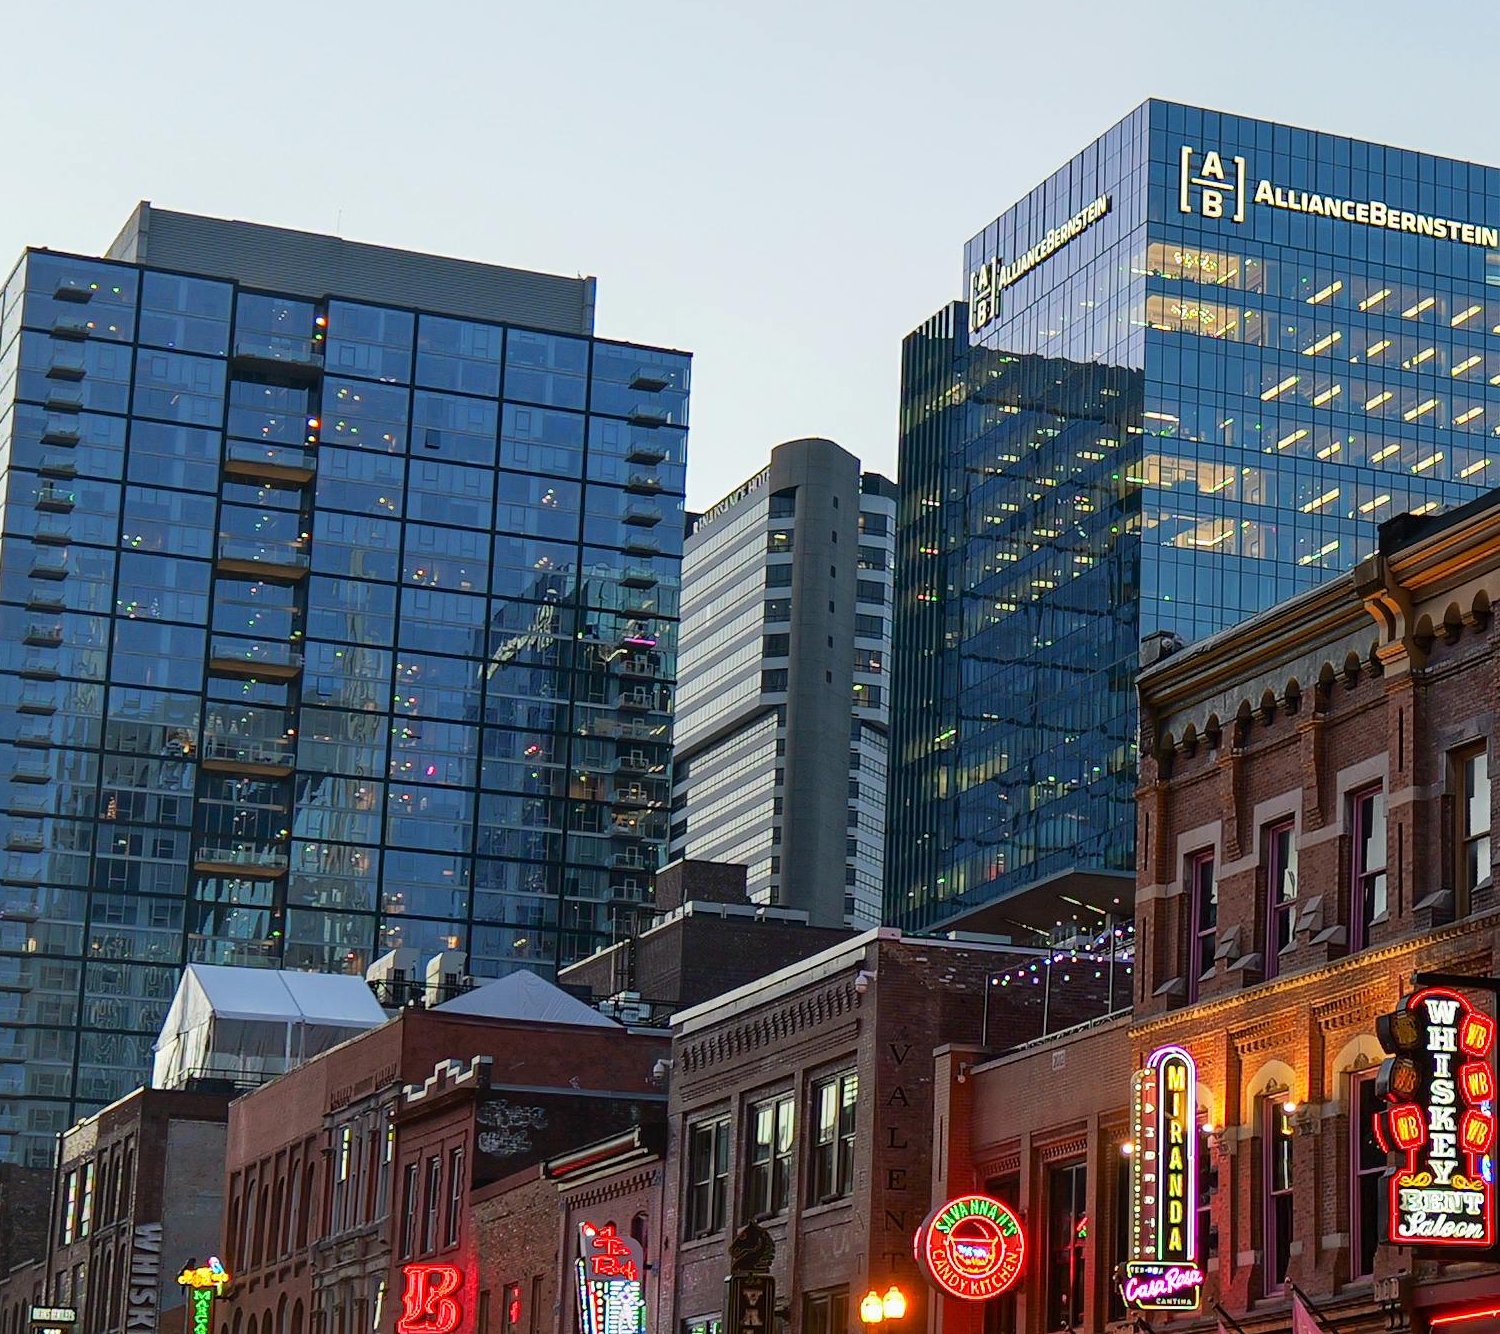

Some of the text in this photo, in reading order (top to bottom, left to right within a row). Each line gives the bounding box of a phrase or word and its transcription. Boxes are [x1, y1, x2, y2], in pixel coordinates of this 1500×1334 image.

[1201, 151, 1225, 180] A
[1202, 190, 1224, 218] B
[1465, 1022, 1488, 1050] WB
[1424, 999, 1460, 1185] WHISKEY
[1469, 1071, 1489, 1096] WB
[1397, 1116, 1419, 1141] WB
[1466, 1118, 1489, 1145] WB
[1167, 1065, 1186, 1252] MIRANDA
[1399, 1189, 1485, 1216] BENT
[935, 1199, 1018, 1237] SAVANNAH'S
[1399, 1210, 1485, 1239] Saloon
[932, 1249, 1019, 1294] CANDY KITCHEN
[1126, 1267, 1203, 1302] Casa Rosa
[1155, 1298, 1193, 1306] CANTINA
